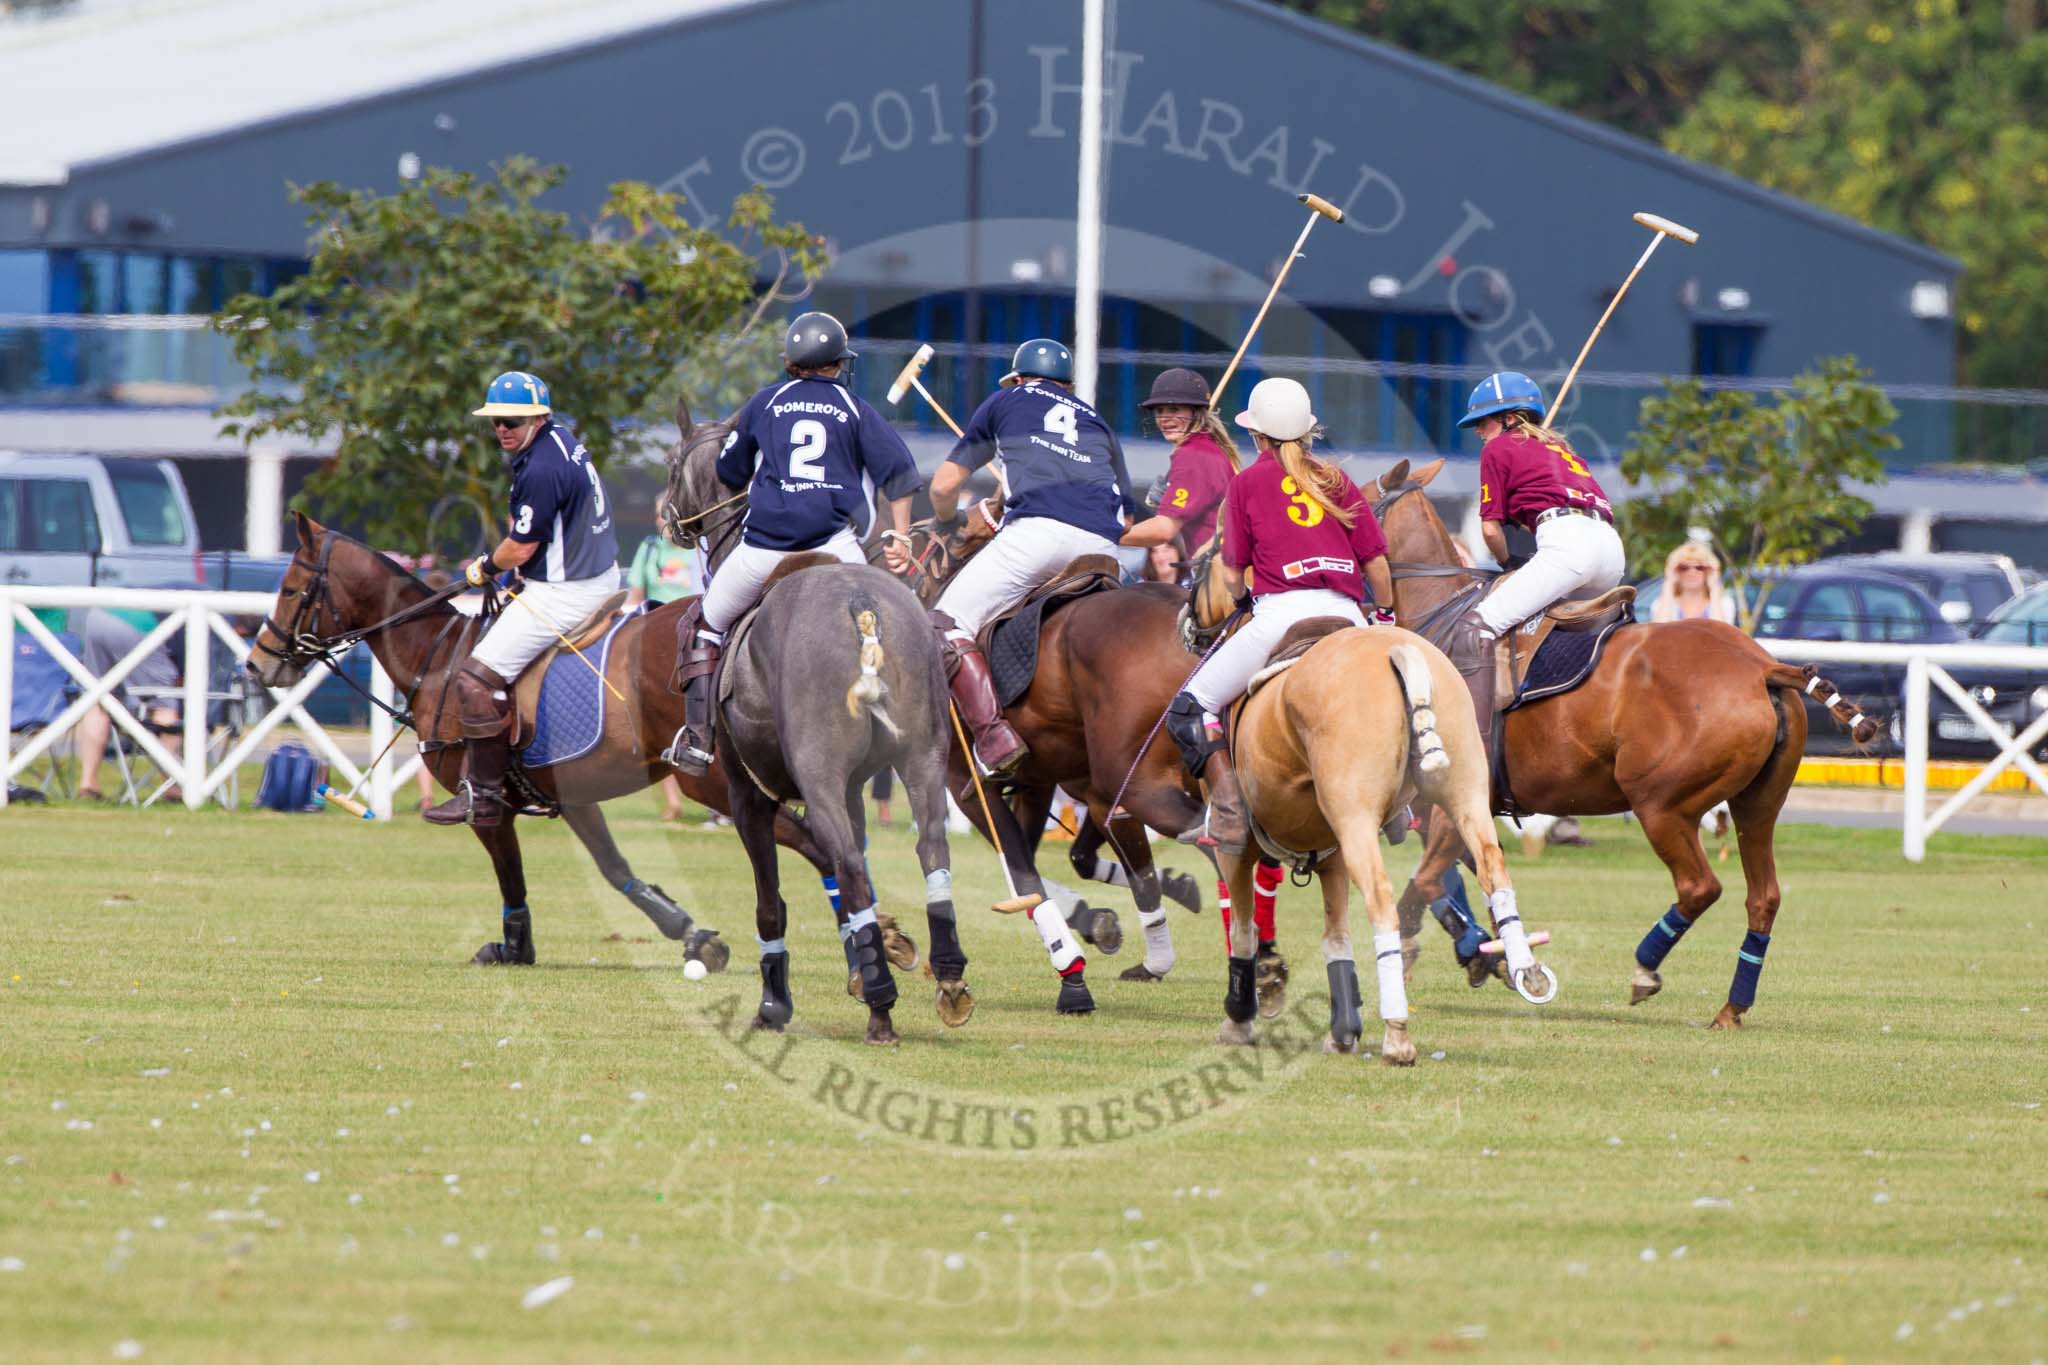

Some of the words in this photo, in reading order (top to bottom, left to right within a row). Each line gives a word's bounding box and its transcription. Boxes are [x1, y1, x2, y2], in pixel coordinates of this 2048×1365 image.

[773, 401, 849, 423] POMEROYS
[1024, 387, 1097, 418] POMEROYS
[1044, 403, 1079, 446] 4
[789, 419, 827, 482] 2
[1545, 444, 1591, 477] 1
[1171, 488, 1189, 508] 2
[1281, 475, 1324, 528] 3
[1481, 483, 1492, 503] 1
[515, 505, 534, 534] 3
